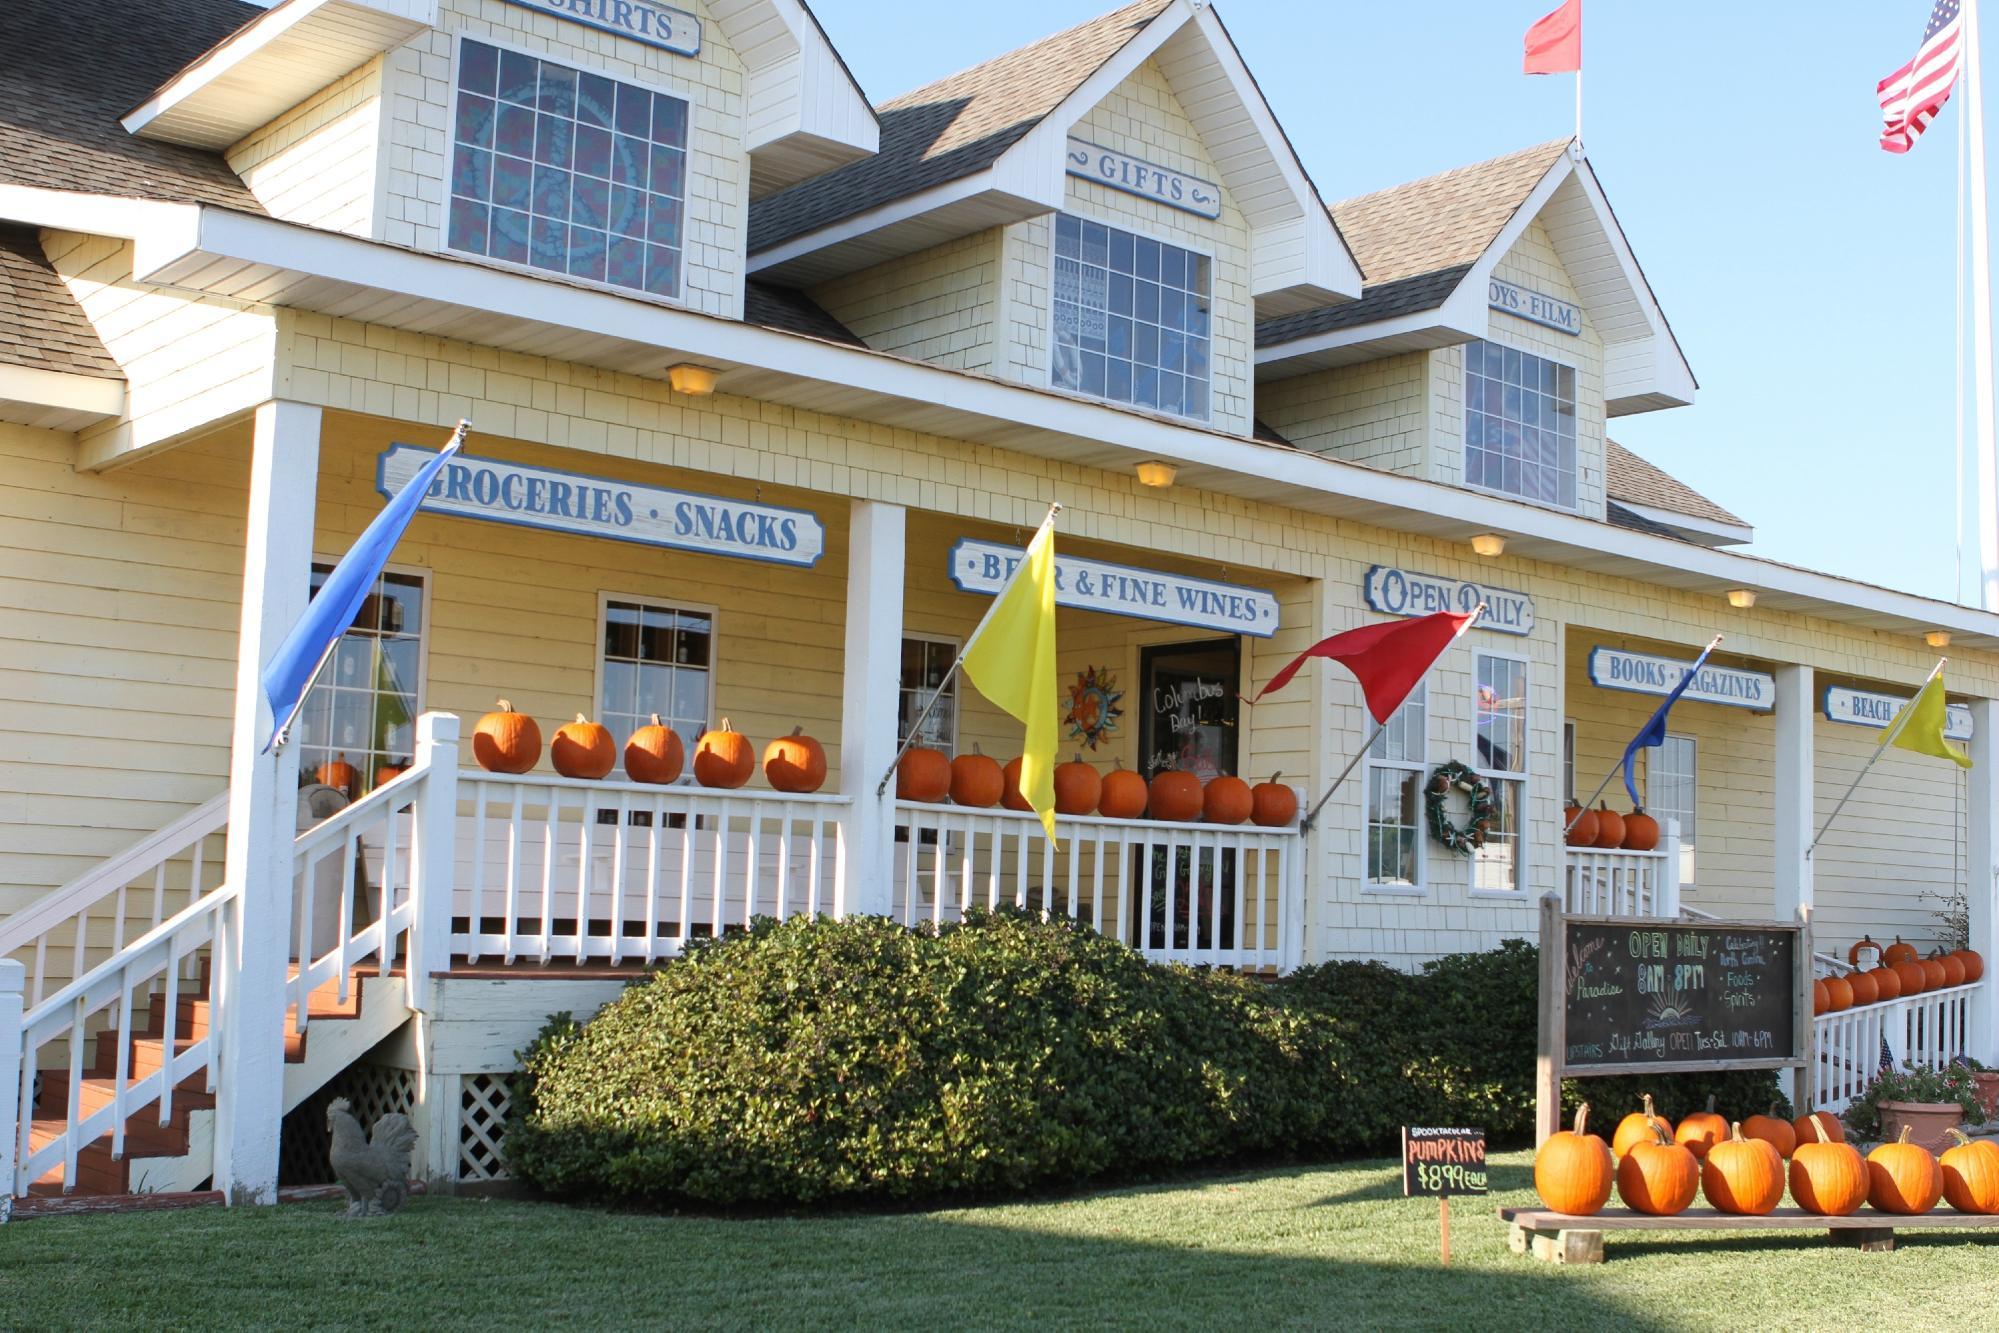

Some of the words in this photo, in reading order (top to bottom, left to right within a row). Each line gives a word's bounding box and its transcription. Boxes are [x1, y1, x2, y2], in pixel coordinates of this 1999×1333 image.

[549, 0, 673, 40] HIRTS
[1099, 155, 1183, 201] GIFTS
[1489, 282, 1519, 309] OYS
[1530, 296, 1572, 328] FILM
[674, 500, 797, 551] SNACKS
[982, 553, 1065, 590] BER
[1075, 570, 1094, 596] &
[1101, 573, 1167, 608] FINE
[1175, 585, 1257, 622] WINES
[1381, 569, 1451, 613] OPEN
[1457, 583, 1524, 627] DAILY
[1610, 656, 1666, 687] BOOKS
[1153, 677, 1224, 713] Columbus
[1852, 696, 1891, 721] BEACH
[1169, 705, 1202, 735] Day!
[1628, 931, 1668, 959] OPEN
[1677, 931, 1710, 959] DAILY
[1577, 976, 1623, 1001] Paradise
[1637, 963, 1665, 994] 8AM
[1674, 964, 1705, 992] 8PM
[1727, 971, 1754, 988] Foods
[1669, 1031, 1693, 1050] OPEN
[1408, 1137, 1486, 1165] PUMPKINS
